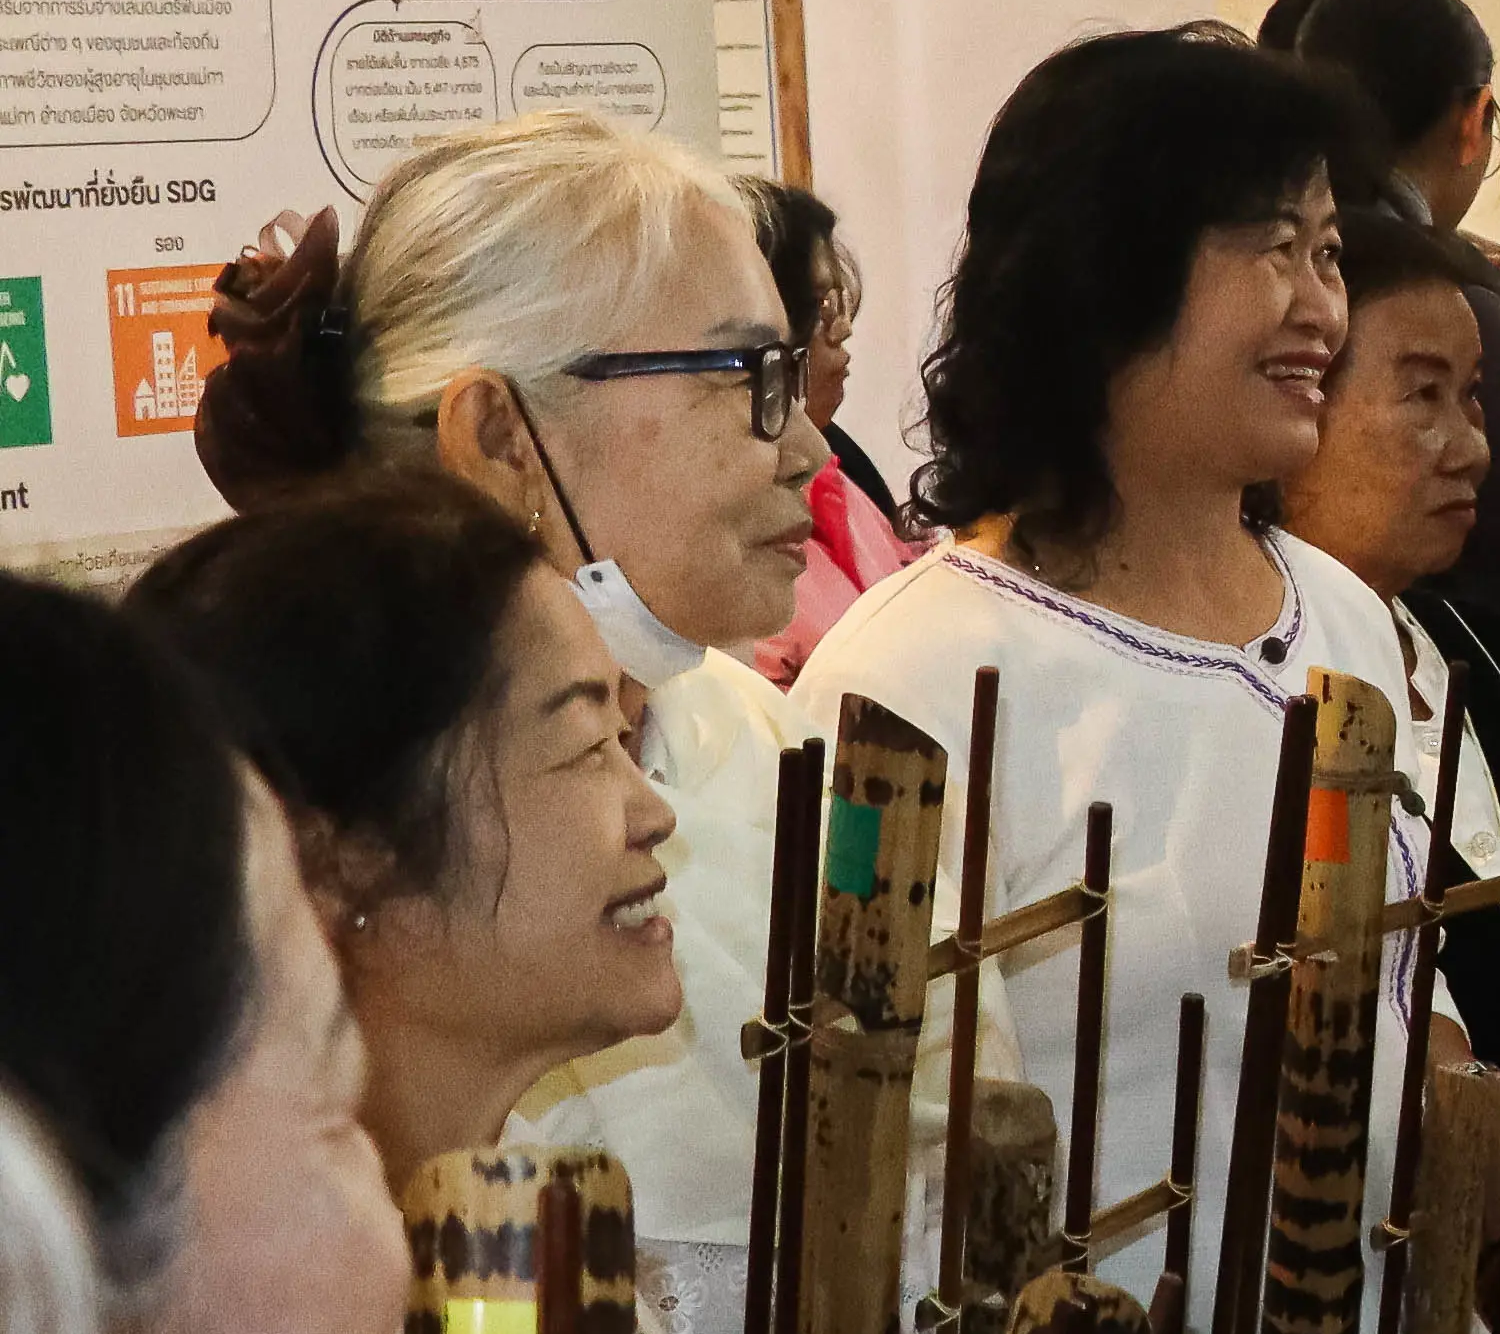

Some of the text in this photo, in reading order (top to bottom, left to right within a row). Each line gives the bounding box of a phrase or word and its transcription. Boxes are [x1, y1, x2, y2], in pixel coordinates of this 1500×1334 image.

[166, 178, 217, 204] SDG
[155, 235, 184, 253] รอง
[0, 481, 30, 511] nt
